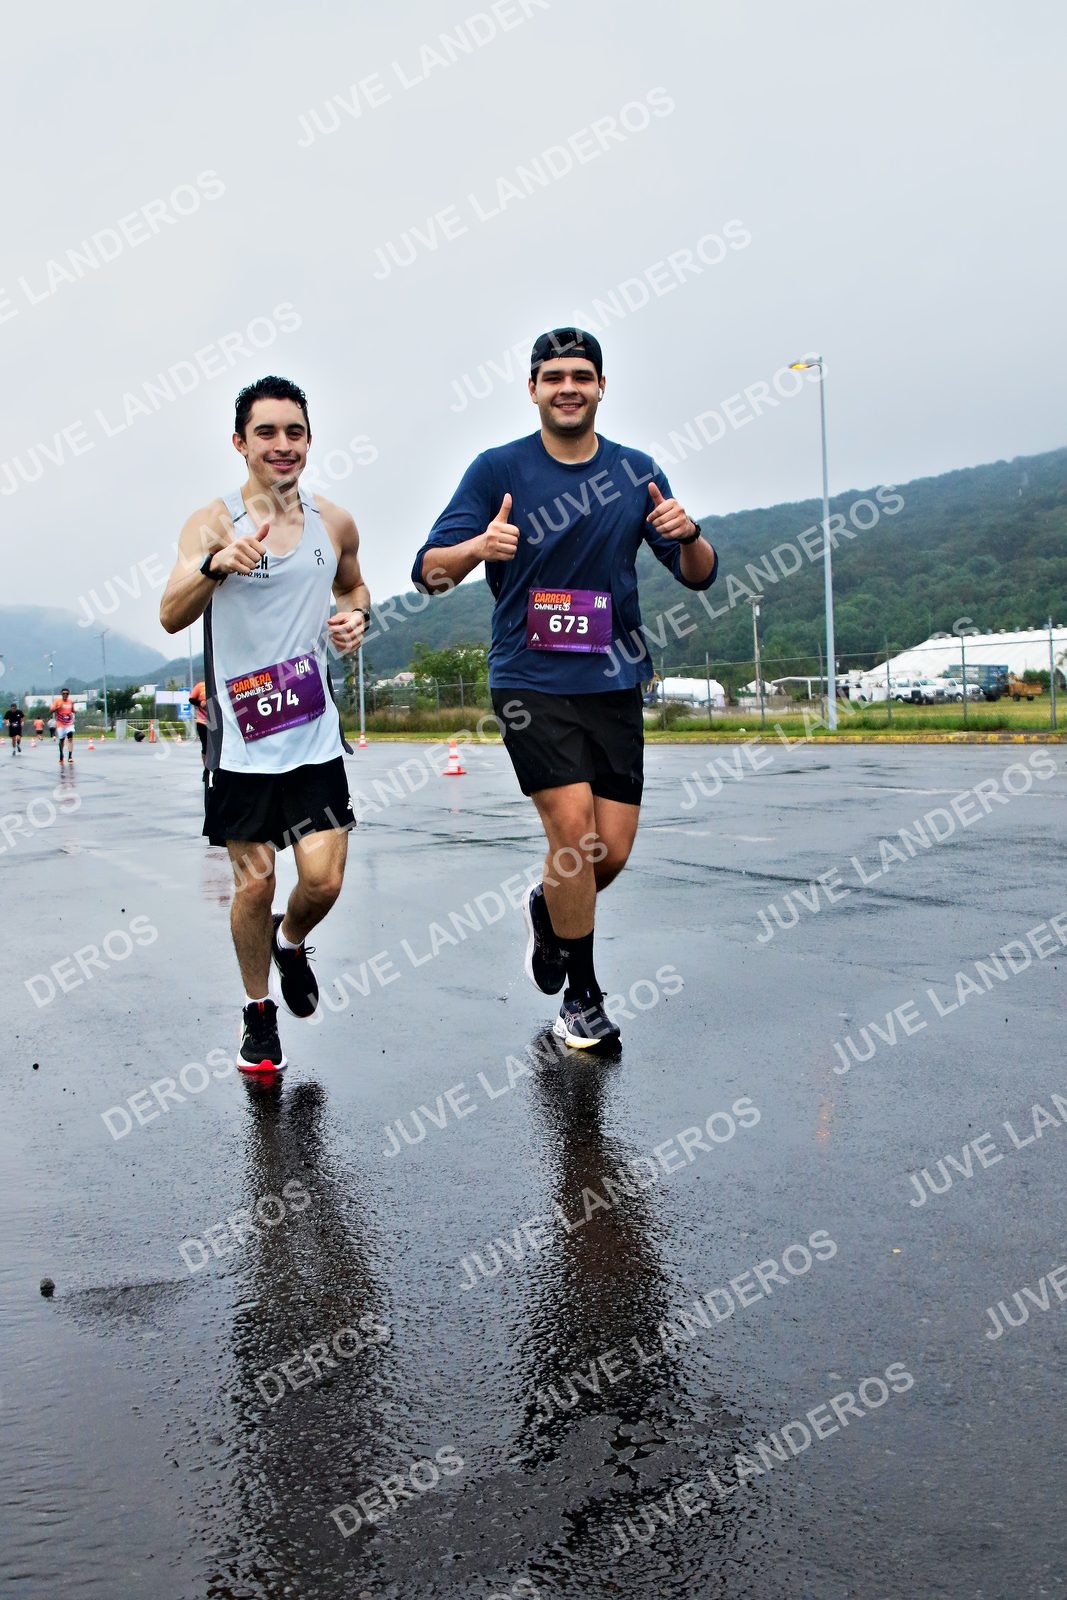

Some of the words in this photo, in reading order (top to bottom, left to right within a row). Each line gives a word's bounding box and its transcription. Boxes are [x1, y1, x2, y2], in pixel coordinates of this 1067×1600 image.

[534, 592, 572, 603] CARRERA
[549, 614, 588, 634] 673
[233, 672, 272, 693] CARRERA
[257, 688, 299, 716] 674
